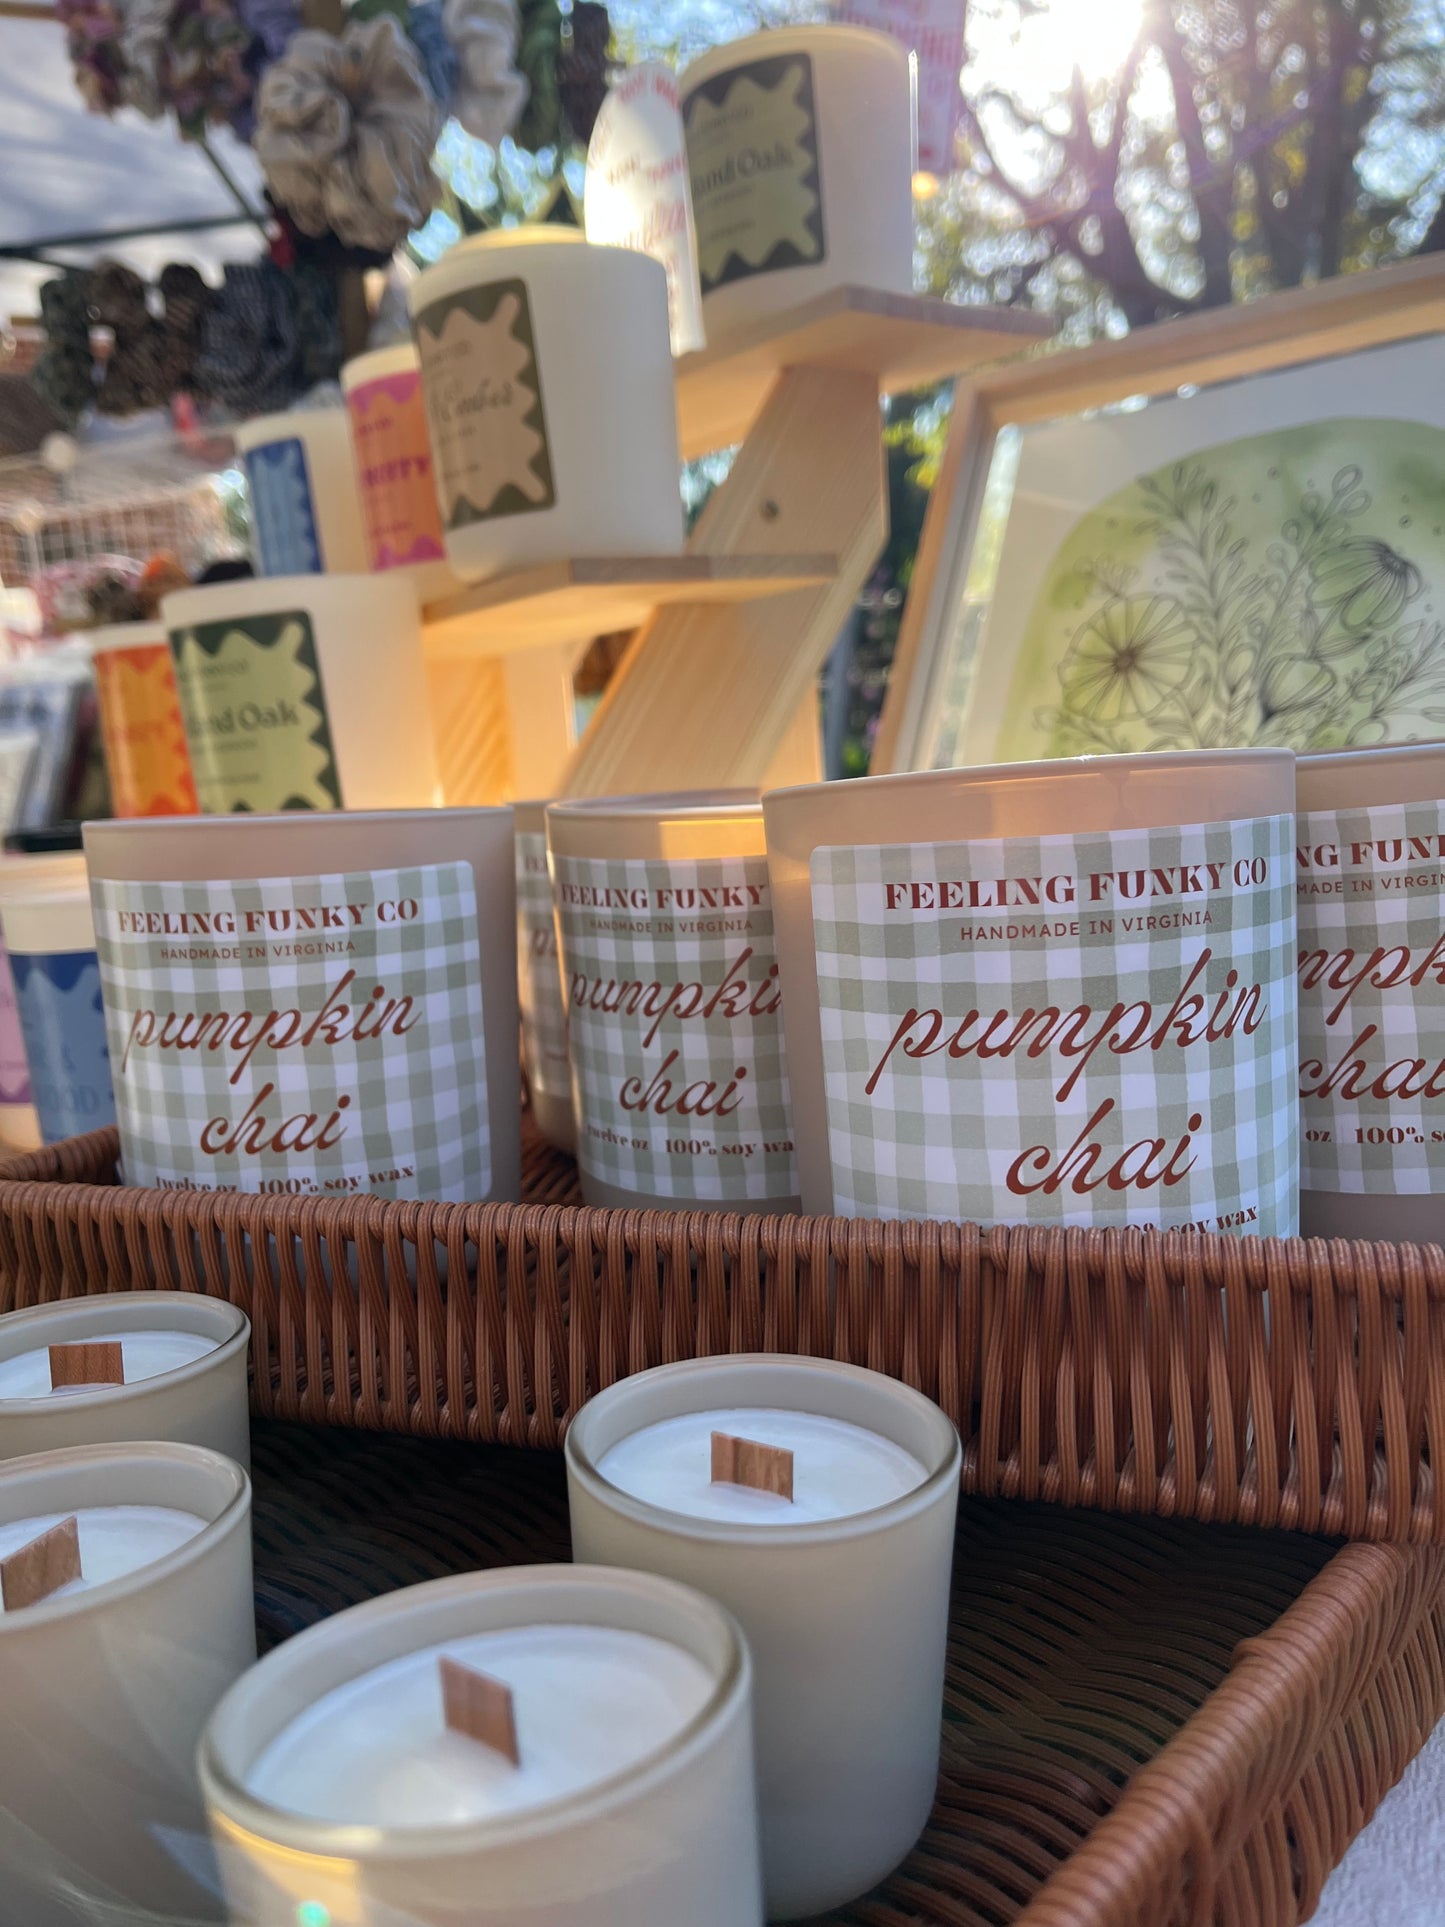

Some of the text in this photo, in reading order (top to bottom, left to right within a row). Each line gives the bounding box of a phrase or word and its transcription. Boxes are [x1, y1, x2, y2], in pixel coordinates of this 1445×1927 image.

[561, 883, 766, 909] FEELING FUNKY
[883, 856, 1268, 911] FEELING FUNKY CO
[1351, 879, 1373, 892] IN
[118, 899, 418, 934] FEELING FUNKY CO
[589, 919, 754, 933] HANDMADE IN VIRGINIA
[960, 910, 1214, 941] HANDMADE IN VIRGINIA
[160, 940, 355, 960] HANDMADE IN VIRGINIA
[122, 969, 422, 1085] pumpkin
[864, 947, 1268, 1102] pumpkin
[619, 1050, 747, 1117] chai
[200, 1082, 350, 1155] chai
[631, 1139, 649, 1151] oz
[665, 1138, 718, 1156] 100%
[721, 1142, 757, 1158] soy
[1005, 1097, 1203, 1195] chai
[1305, 1129, 1332, 1143] oz
[1354, 1126, 1425, 1144] 100%
[257, 1176, 319, 1195] 100%
[323, 1175, 363, 1192] soy
[368, 1164, 415, 1186] wax
[1216, 1206, 1258, 1230] wax
